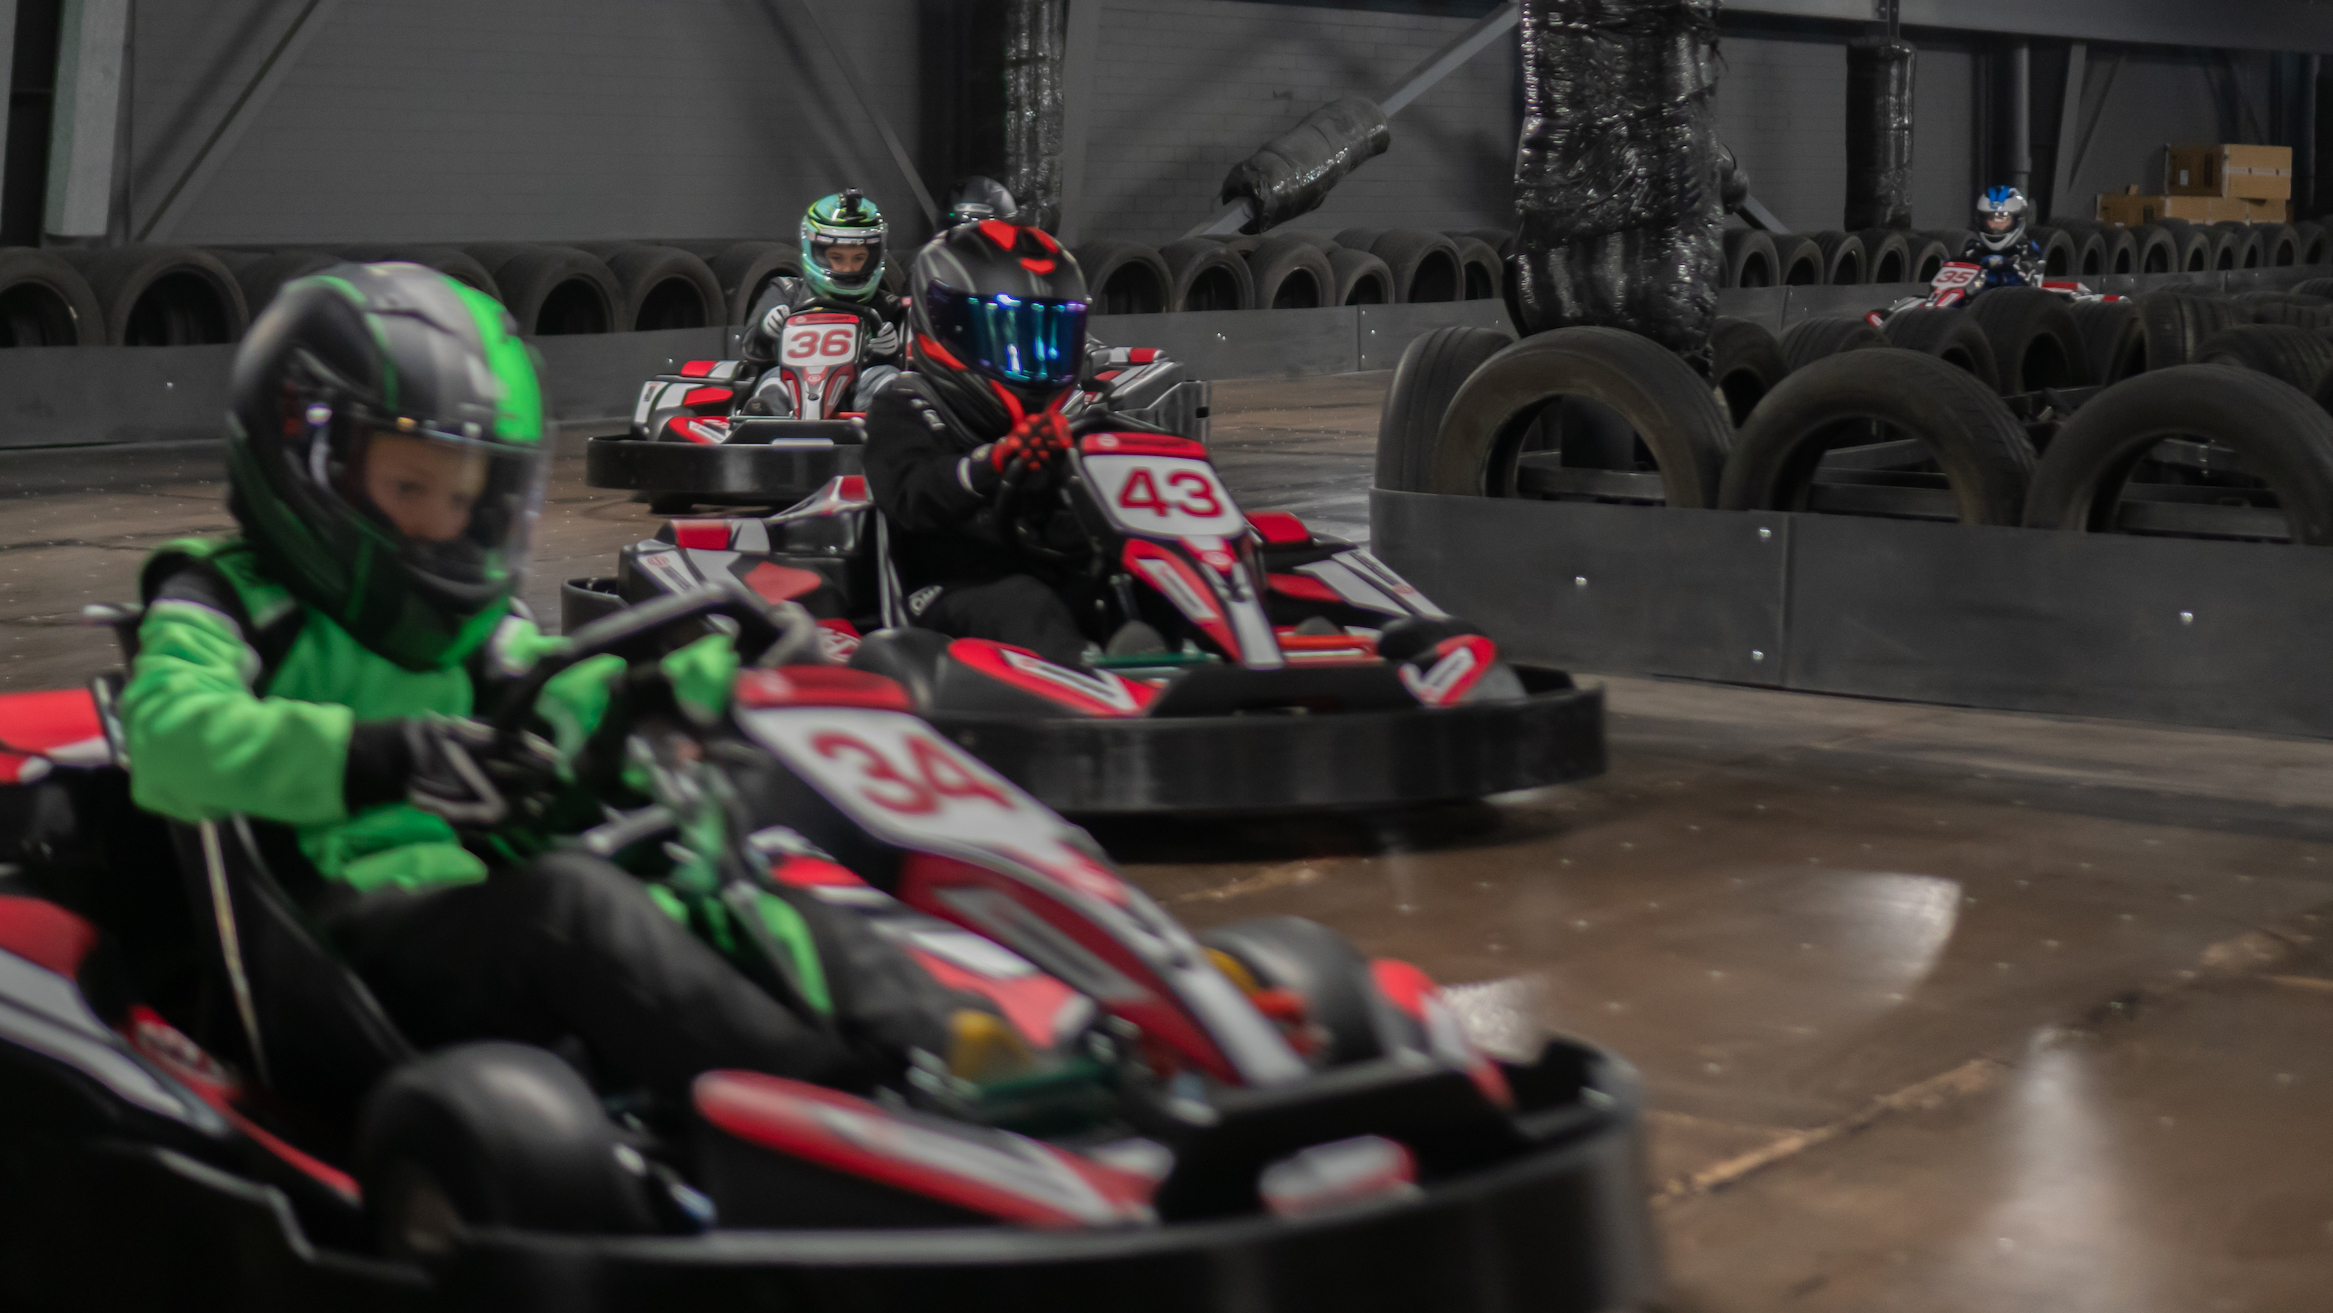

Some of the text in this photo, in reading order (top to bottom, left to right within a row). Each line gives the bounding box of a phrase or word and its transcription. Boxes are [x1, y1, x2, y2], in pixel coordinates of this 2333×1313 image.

[1936, 270, 1974, 284] 35
[787, 329, 853, 358] 36
[1118, 467, 1224, 518] 43
[809, 731, 1016, 816] 34
